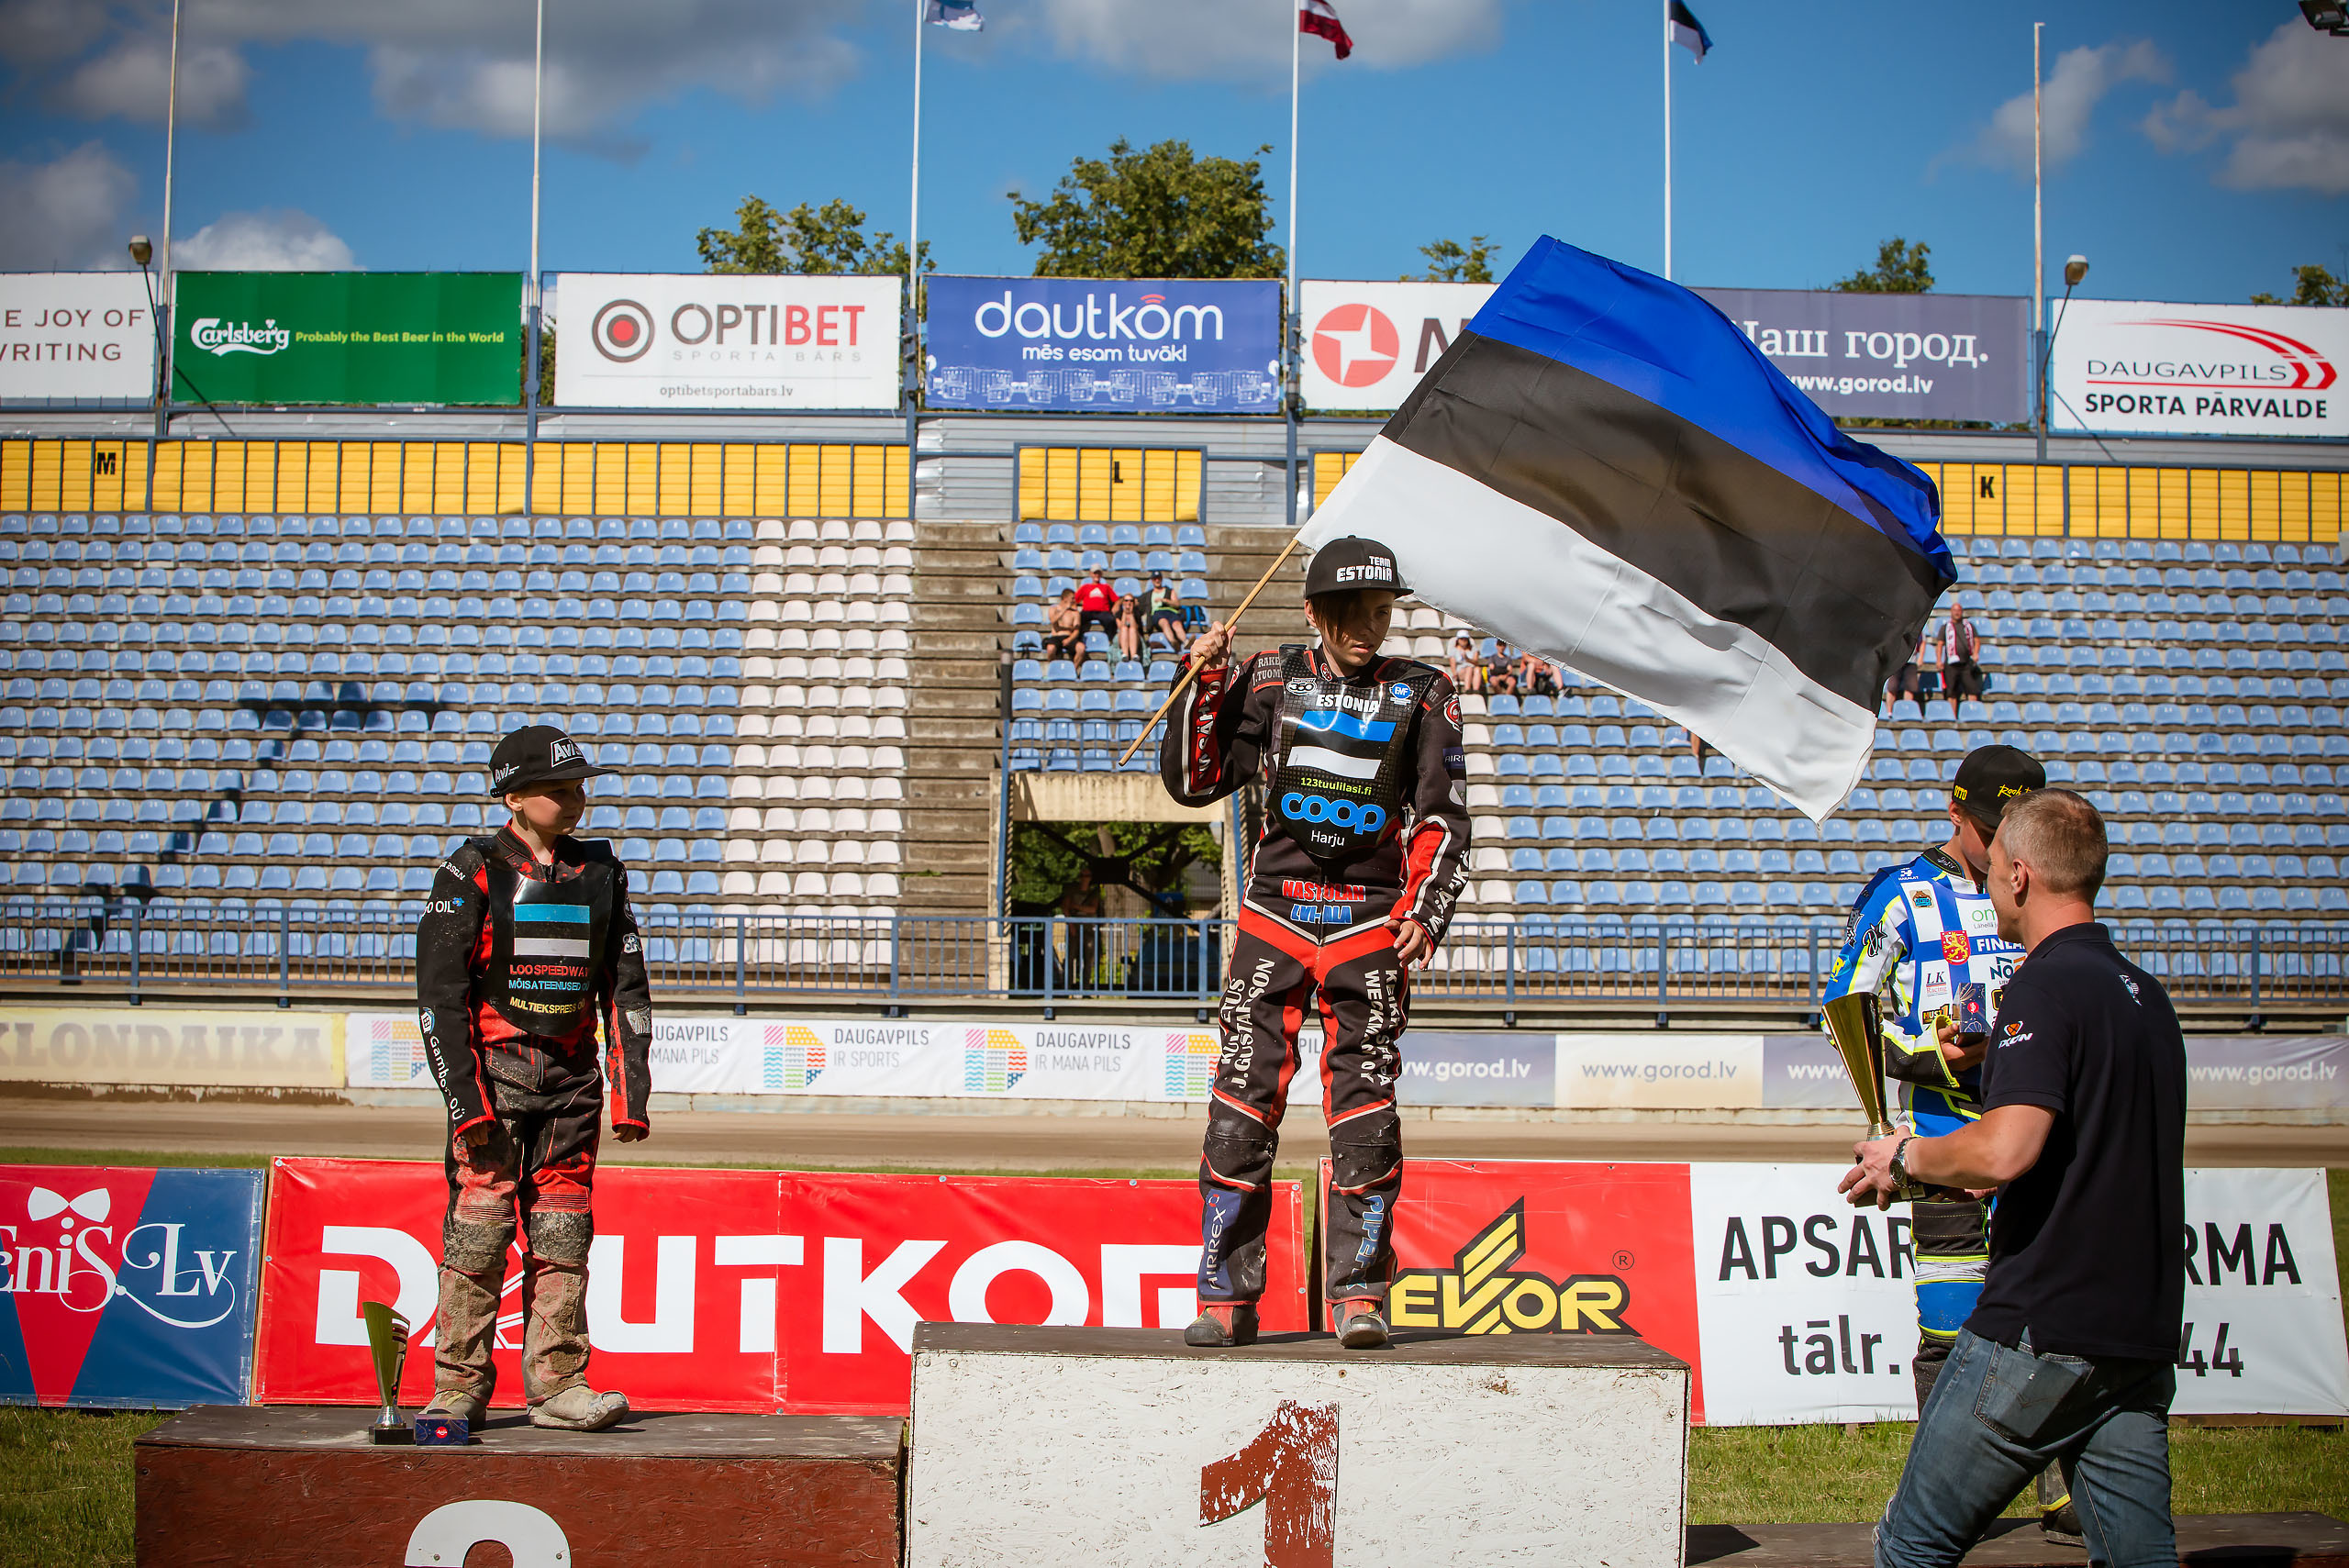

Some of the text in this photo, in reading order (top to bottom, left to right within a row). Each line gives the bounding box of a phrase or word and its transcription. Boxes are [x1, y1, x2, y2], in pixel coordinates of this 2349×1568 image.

[5, 308, 145, 328] E JOY OF
[671, 303, 865, 346] OPTIBET
[974, 290, 1224, 340] dautkom
[190, 317, 291, 357] Carlsberg
[295, 331, 505, 344] Probably the Best Beer in the World
[673, 350, 775, 361] SPORTA
[1022, 343, 1187, 362] mēs esam tuvāk!
[1844, 331, 1989, 369] город.
[2087, 360, 2288, 381] DAUGAVPILS
[660, 384, 794, 398] optibetsportabars.lv
[2085, 392, 2328, 418] SPORTA PĀRVALDE
[96, 452, 117, 475] M
[1114, 461, 1124, 484] L
[1979, 476, 1996, 499] K
[1369, 555, 1391, 567] TEAM
[1336, 564, 1393, 583] ESTONIA
[1316, 694, 1380, 713] ESTONIA
[1300, 777, 1373, 796] 123tuulilasi.fi
[1281, 792, 1386, 836] coop
[1310, 829, 1345, 848] Harju
[1282, 879, 1366, 903] NASTOLAN
[435, 900, 456, 914] OIL
[1972, 908, 1996, 922] om
[1927, 971, 1944, 984] LK
[655, 1026, 729, 1042] UGAVPILS
[834, 1028, 930, 1046] DAUGAVPILS
[1036, 1031, 1130, 1050] DAUGAVPILS
[0, 1021, 328, 1073] LONDAIKA
[1298, 1038, 1321, 1054] PIL
[692, 1050, 718, 1064] PILS
[833, 1051, 900, 1069] IR SPORTS
[1035, 1055, 1121, 1072] IR MANA PILS
[1360, 1061, 1376, 1084] OY
[1581, 1060, 1738, 1083] www.gorod.lv
[2188, 1061, 2338, 1085] www.gorod.lv
[1206, 1207, 1227, 1290] AIRREX
[1718, 1213, 2303, 1287] APSAR RMA
[1777, 1314, 1901, 1377] tālr.
